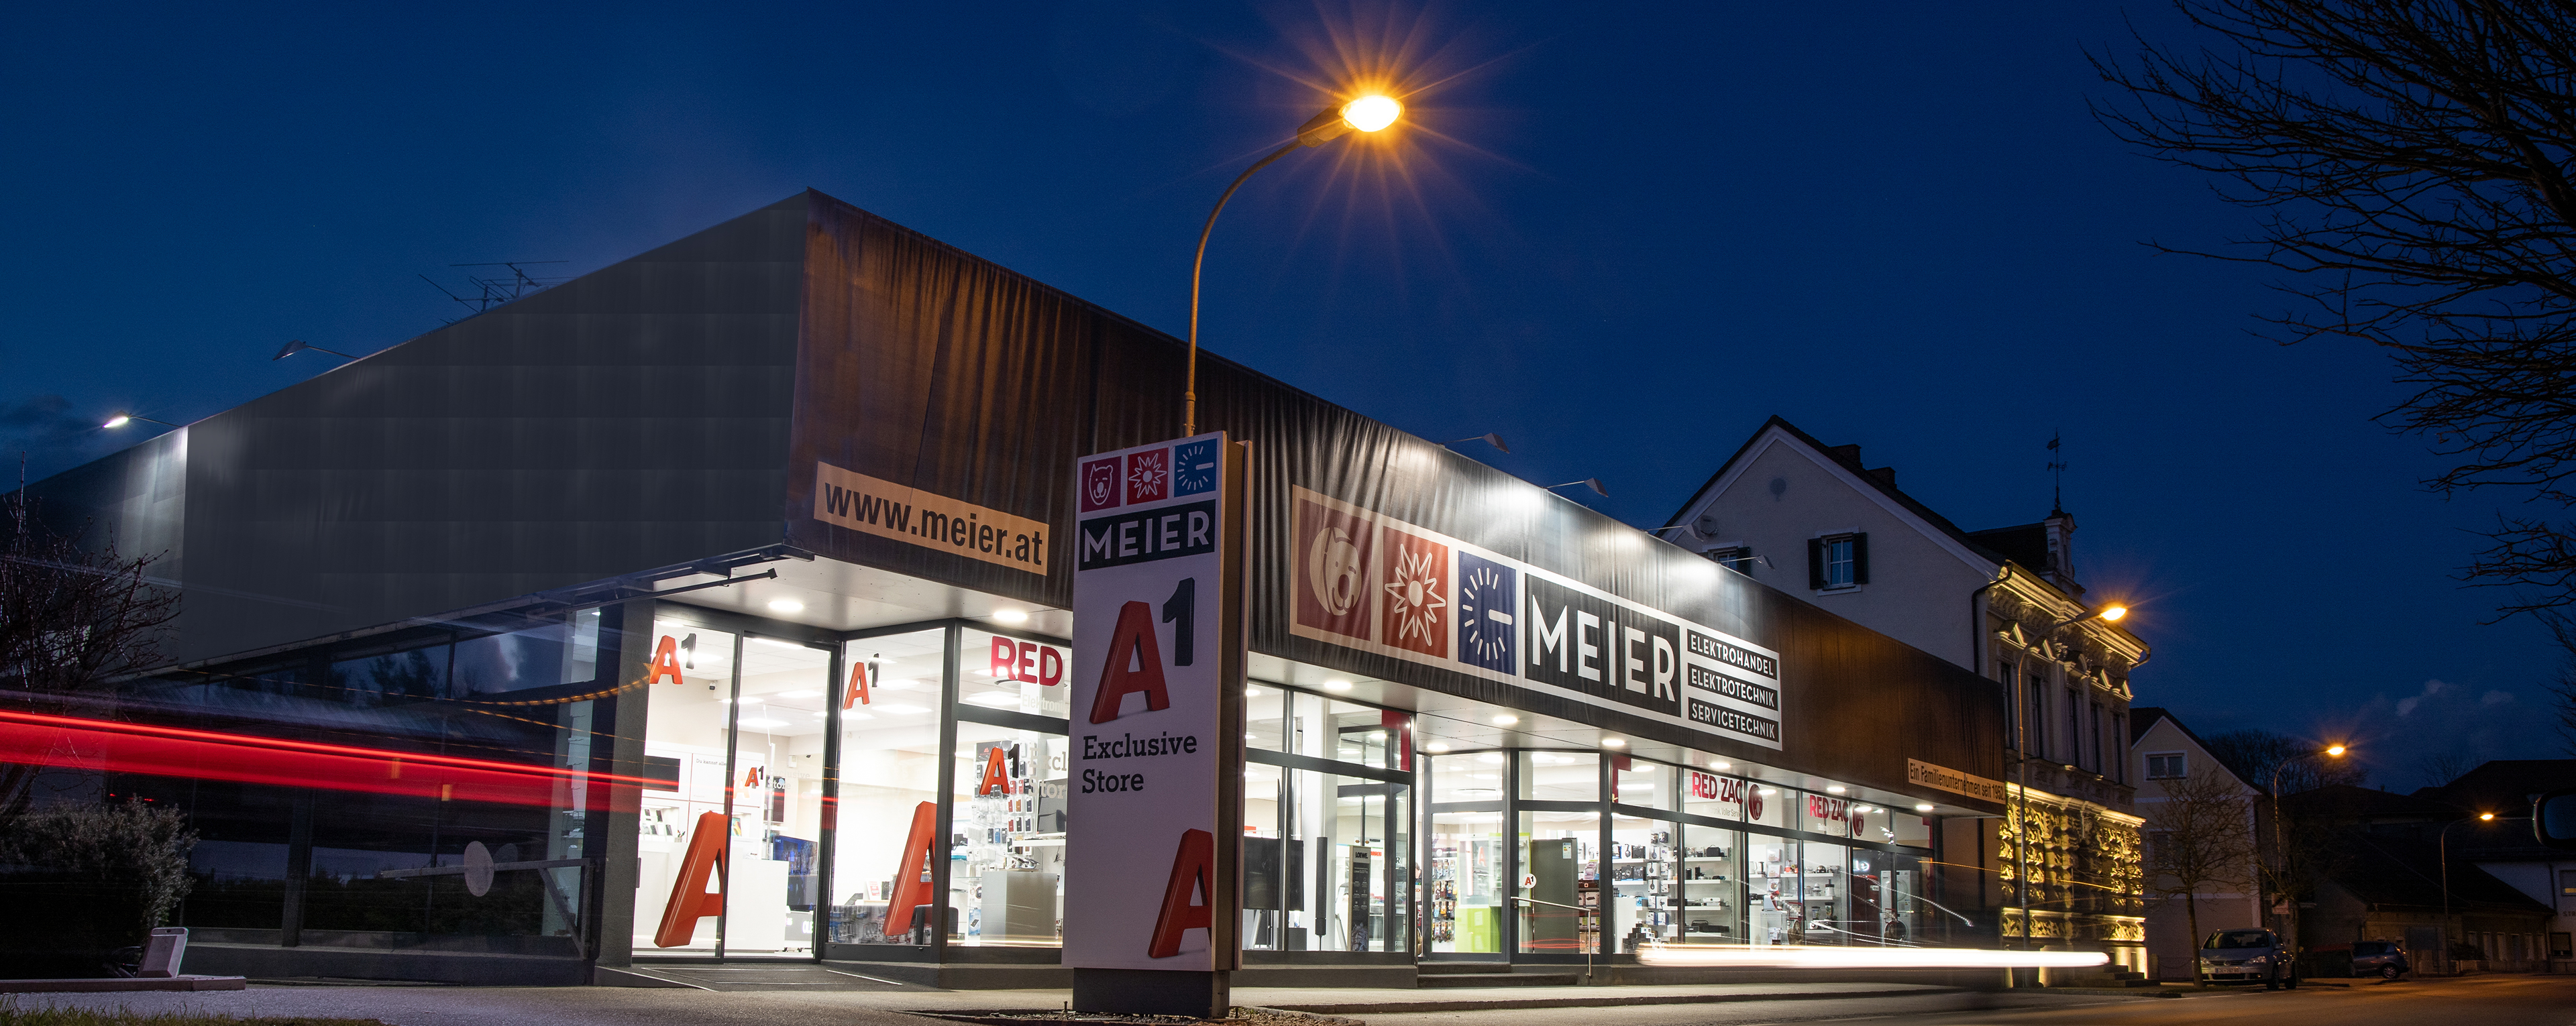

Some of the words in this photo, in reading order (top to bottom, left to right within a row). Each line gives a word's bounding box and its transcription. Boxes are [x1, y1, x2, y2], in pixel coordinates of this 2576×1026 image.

[824, 482, 1042, 565] www.meier.at
[1084, 510, 1210, 563] MEIER
[649, 633, 696, 685] A1
[991, 636, 1063, 687] RED
[1089, 577, 1195, 725] A1
[1532, 594, 1676, 702] MEIER
[1690, 634, 1774, 676] ELEKTROHANDEL
[843, 652, 879, 709] A1
[1691, 668, 1774, 707] ELEKTROTECHNIK
[1692, 703, 1775, 739] SERVICETECHNIK
[1029, 747, 1067, 772] Excl
[1083, 731, 1197, 760] Exclusive
[745, 765, 764, 787] A1
[979, 743, 1020, 795] A1
[1028, 776, 1067, 799] Stor
[1082, 768, 1144, 793] Store
[1910, 762, 1919, 781] Ein
[1921, 765, 1980, 795] Familienunternehmen
[1982, 783, 1991, 798] seit
[1693, 772, 1717, 799] RED
[1721, 778, 1743, 805] ZAC
[1809, 795, 1829, 819] RED
[1831, 799, 1849, 823] ZAC
[1525, 876, 1534, 885] A1
